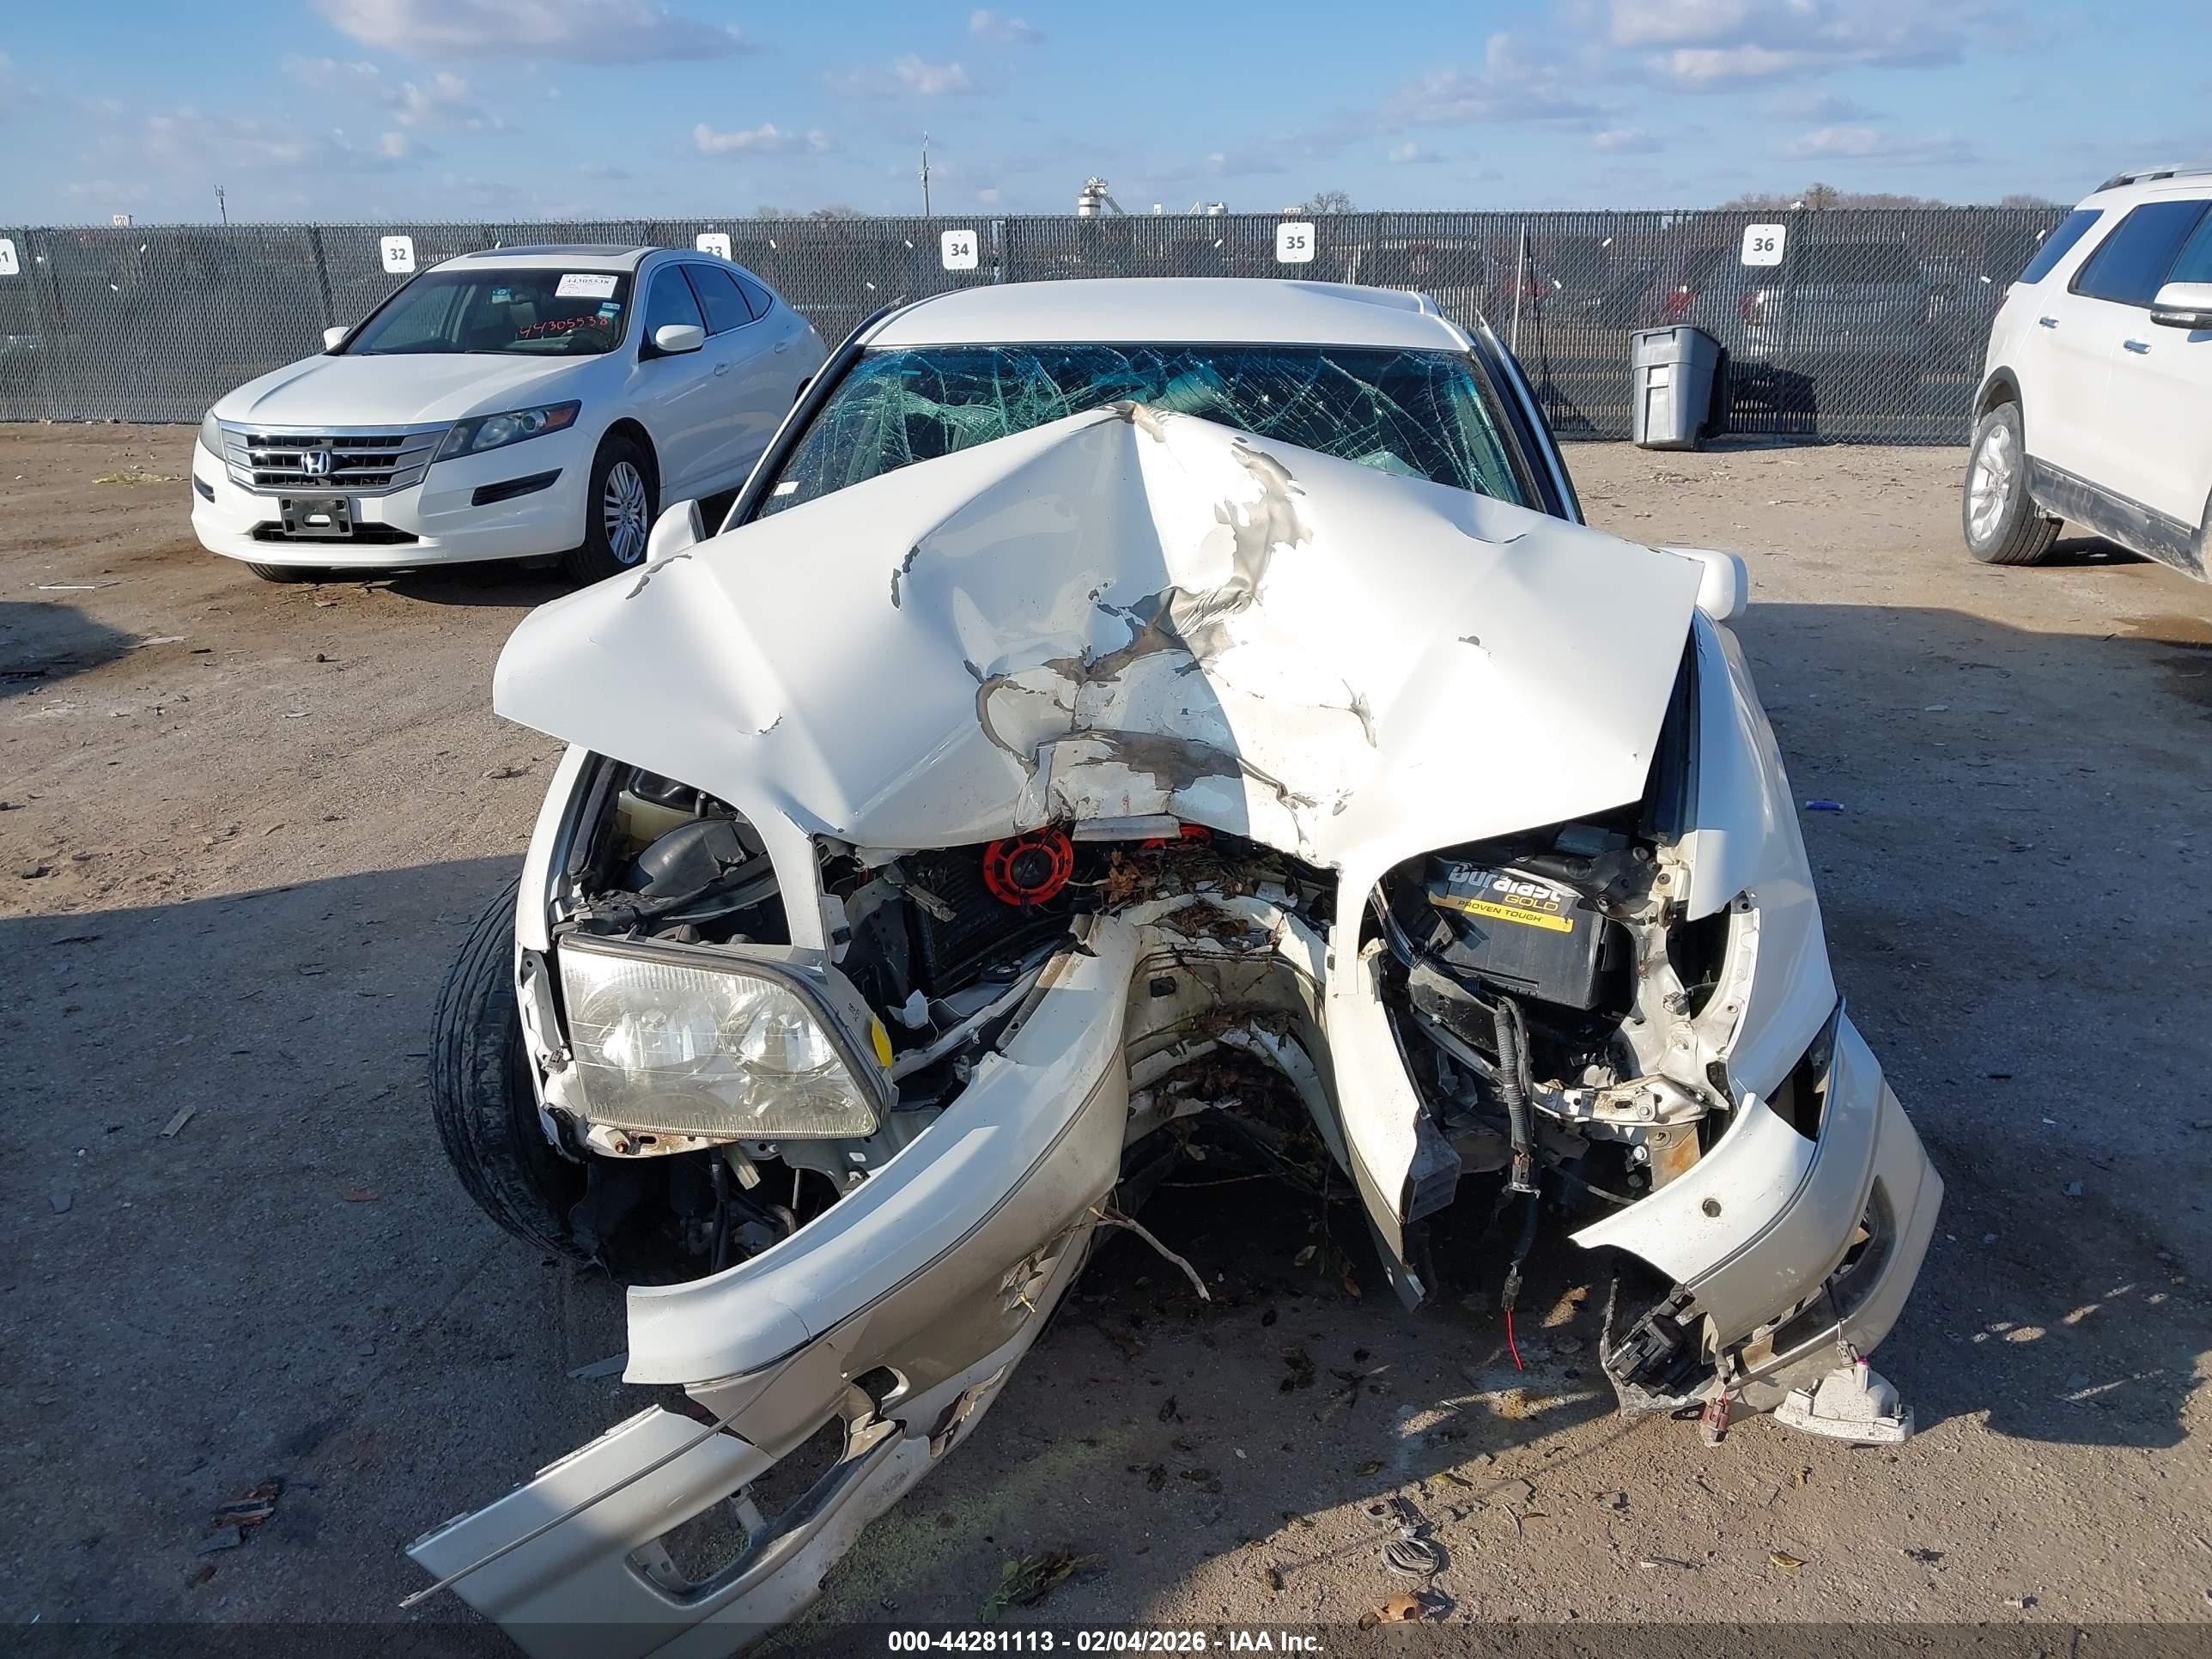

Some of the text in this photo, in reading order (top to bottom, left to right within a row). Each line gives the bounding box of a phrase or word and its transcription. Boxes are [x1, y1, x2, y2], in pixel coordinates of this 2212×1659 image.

[951, 242, 969, 257] 34
[1285, 235, 1305, 250] 35
[1753, 237, 1775, 252] 36
[390, 247, 407, 261] 32
[520, 315, 609, 338] 44305538
[1504, 893, 1559, 912] GOLD
[1457, 900, 1542, 922] PROVEN TOUGH
